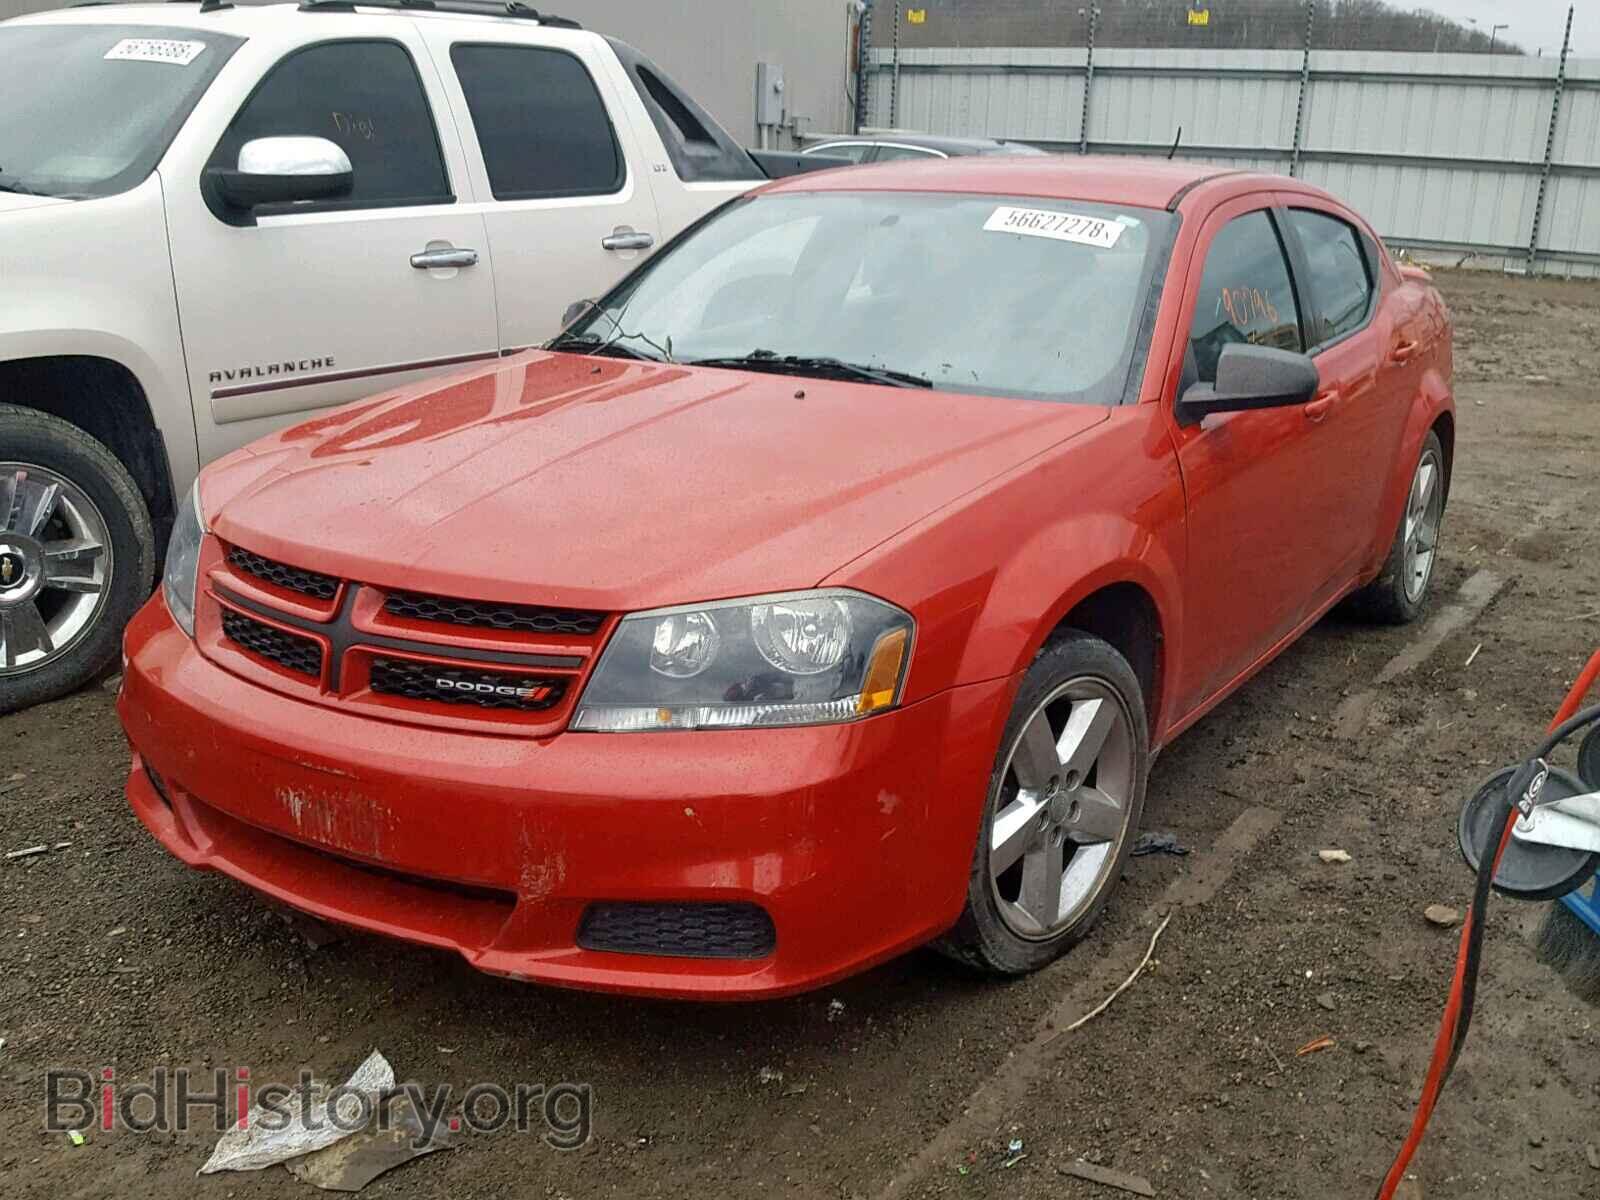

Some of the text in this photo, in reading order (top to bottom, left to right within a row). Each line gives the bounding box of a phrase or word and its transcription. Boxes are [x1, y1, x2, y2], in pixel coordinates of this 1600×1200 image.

[1004, 210, 1105, 239] 56627278
[208, 356, 336, 382] AVALANCHE
[436, 678, 535, 697] DODGE
